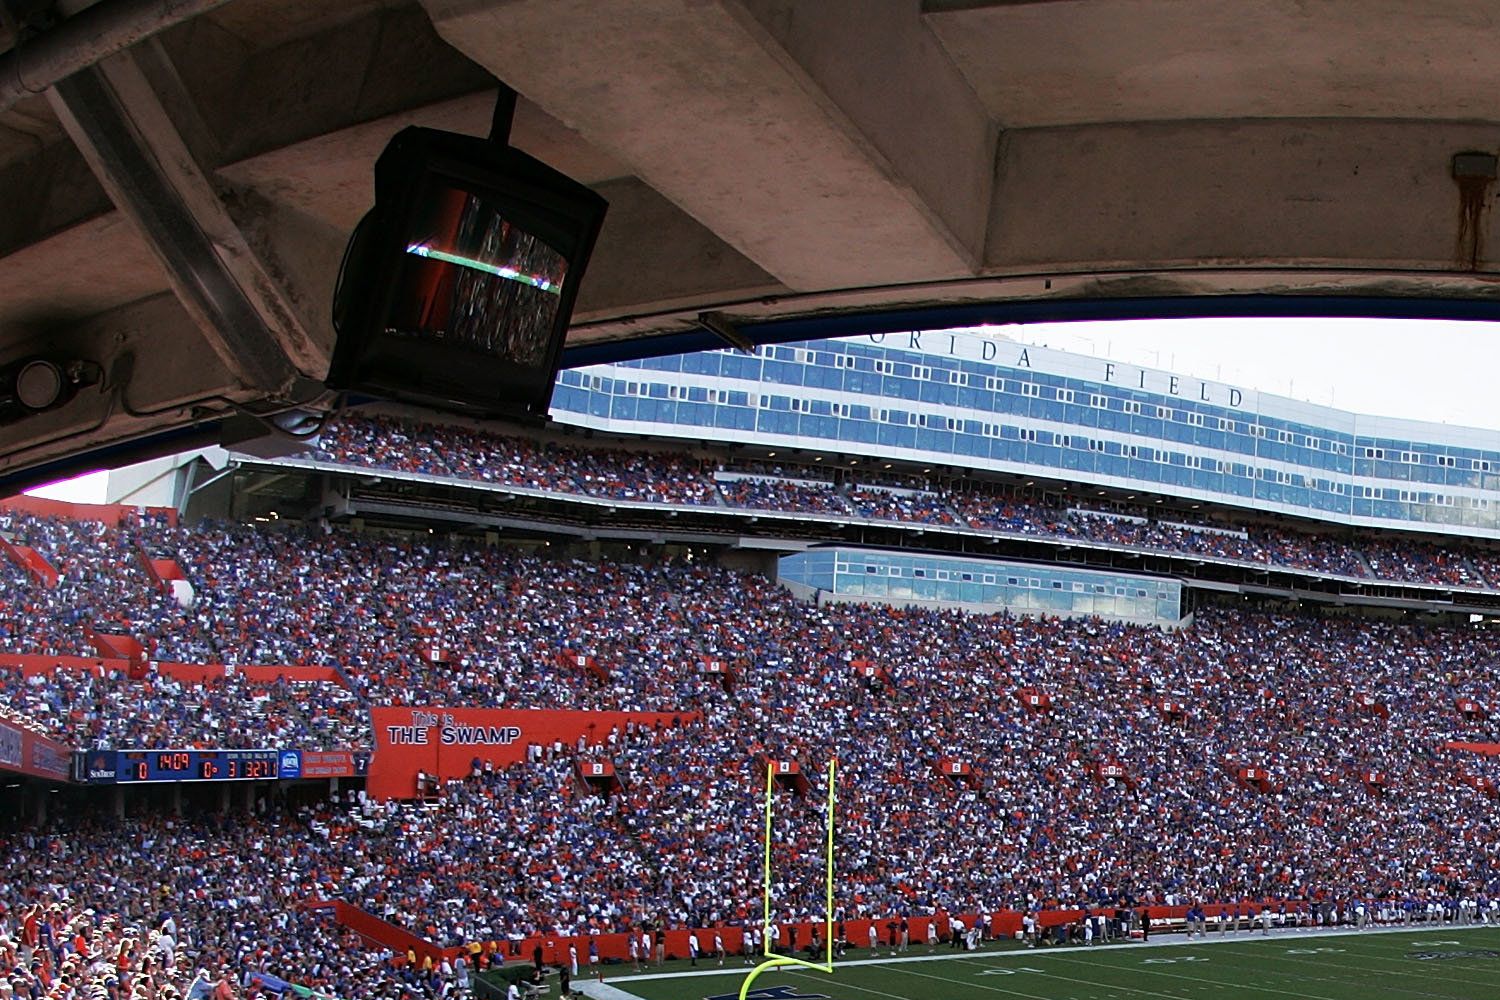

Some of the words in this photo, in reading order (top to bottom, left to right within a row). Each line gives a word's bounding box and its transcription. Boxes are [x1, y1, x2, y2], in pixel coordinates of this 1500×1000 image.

[1104, 363, 1243, 407] FIELD
[411, 711, 438, 727] This
[387, 726, 428, 744] THE
[441, 726, 521, 745] SWAMP
[139, 762, 147, 779] 0
